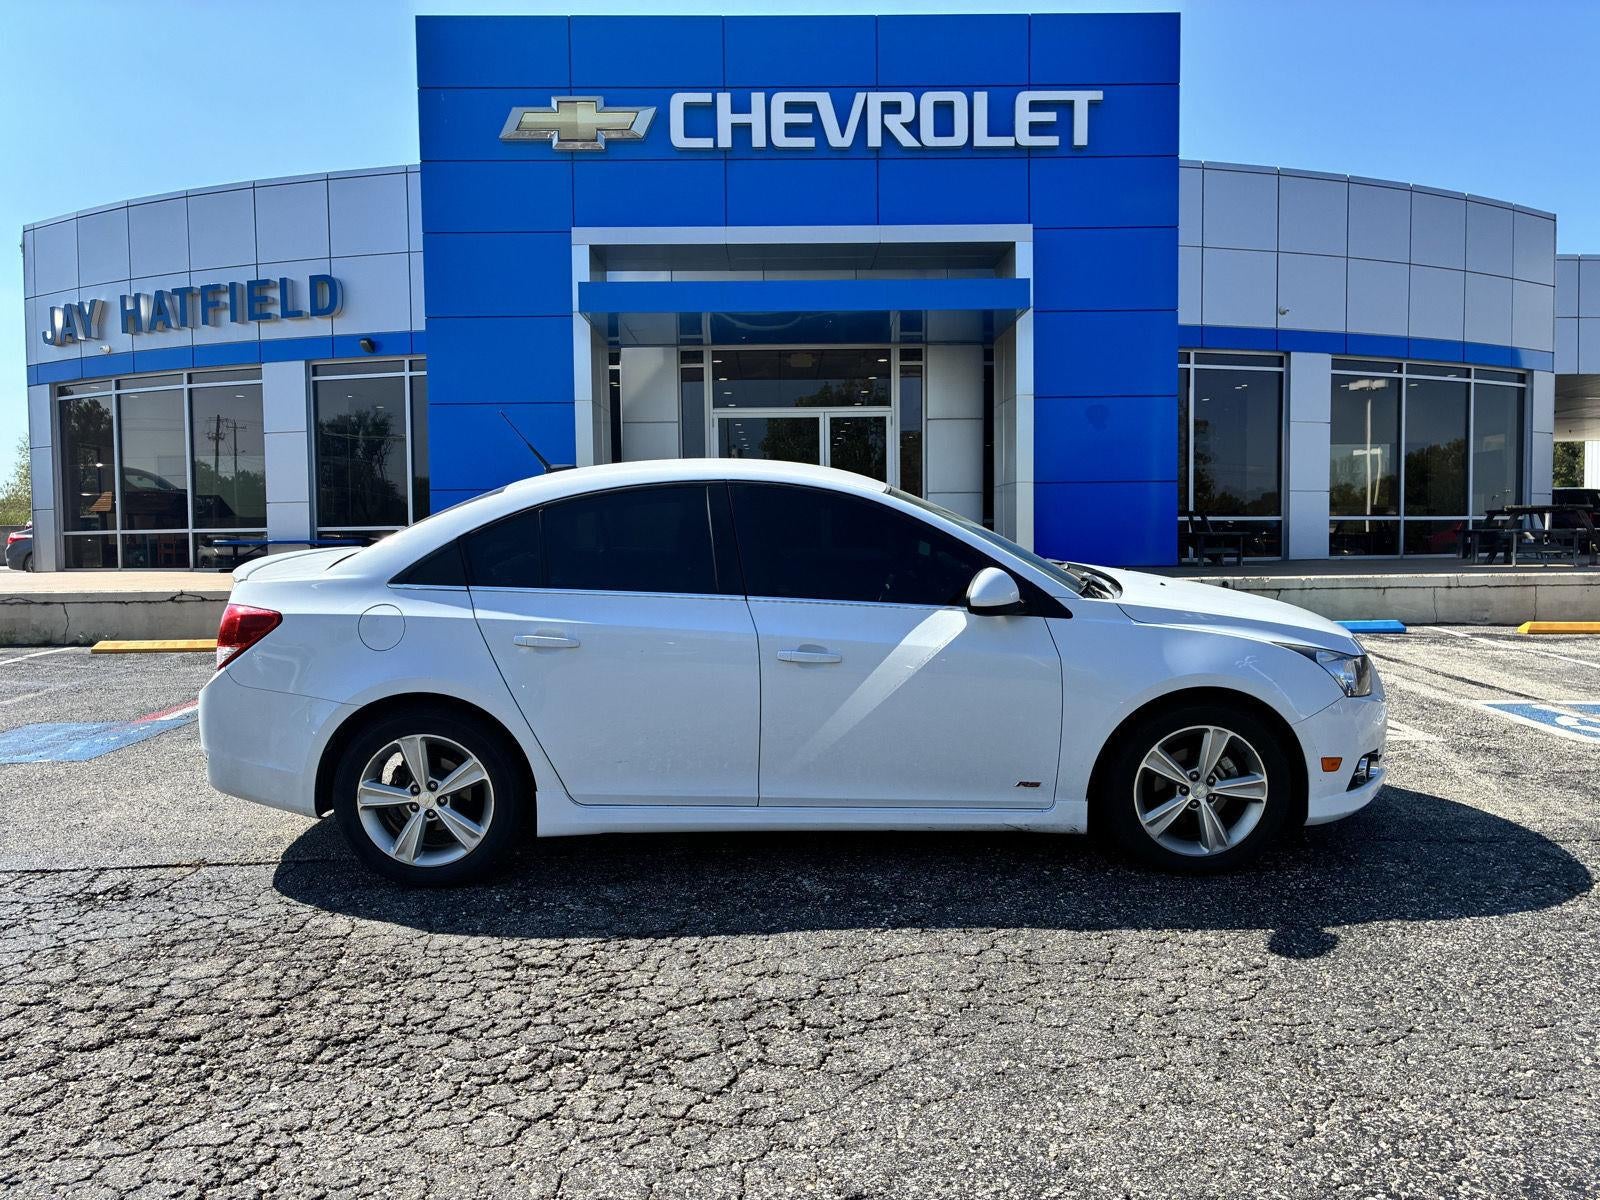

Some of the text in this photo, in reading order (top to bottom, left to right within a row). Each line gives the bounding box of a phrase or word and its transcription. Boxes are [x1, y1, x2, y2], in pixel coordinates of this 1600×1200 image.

[670, 91, 1104, 149] CHEVROLET
[42, 274, 344, 347] JAY HATFIELD
